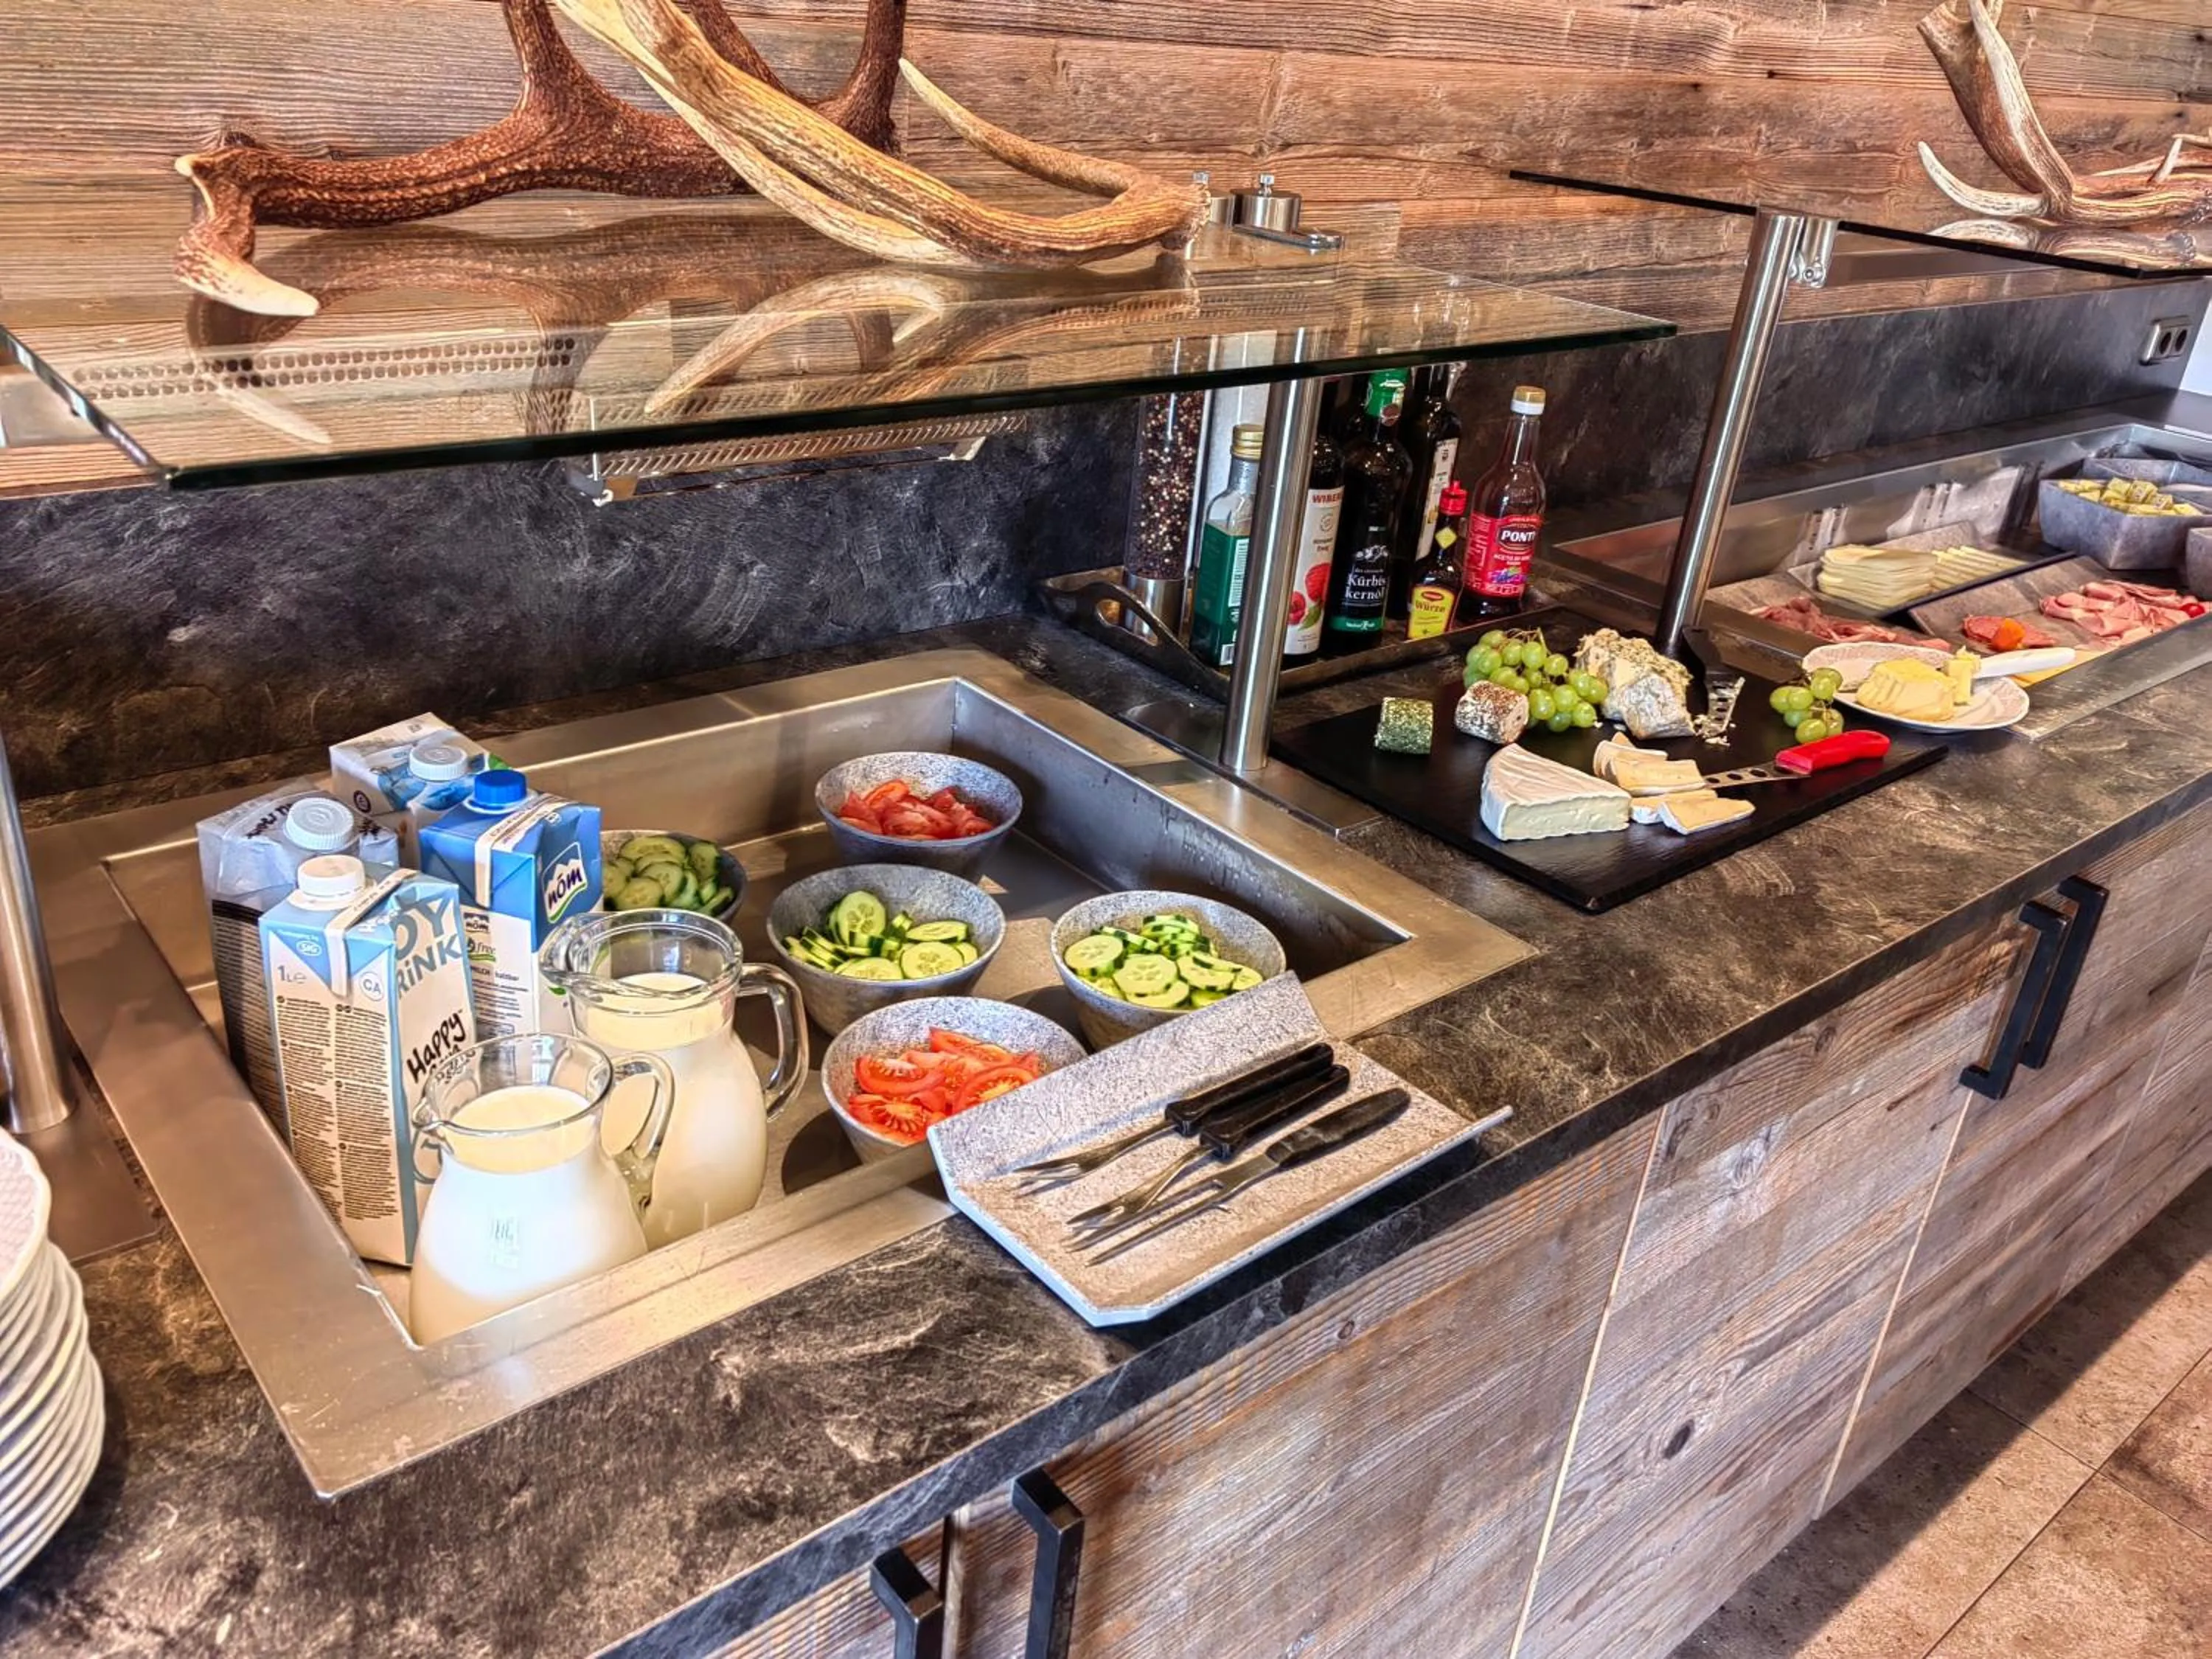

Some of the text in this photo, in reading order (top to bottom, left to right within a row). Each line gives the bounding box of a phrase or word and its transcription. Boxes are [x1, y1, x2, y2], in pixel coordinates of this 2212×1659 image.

[1347, 572, 1386, 587] Kürbis
[1345, 586, 1385, 599] kernöl
[1415, 599, 1446, 613] Würze
[362, 978, 382, 995] CA
[407, 1012, 466, 1084] Happy
